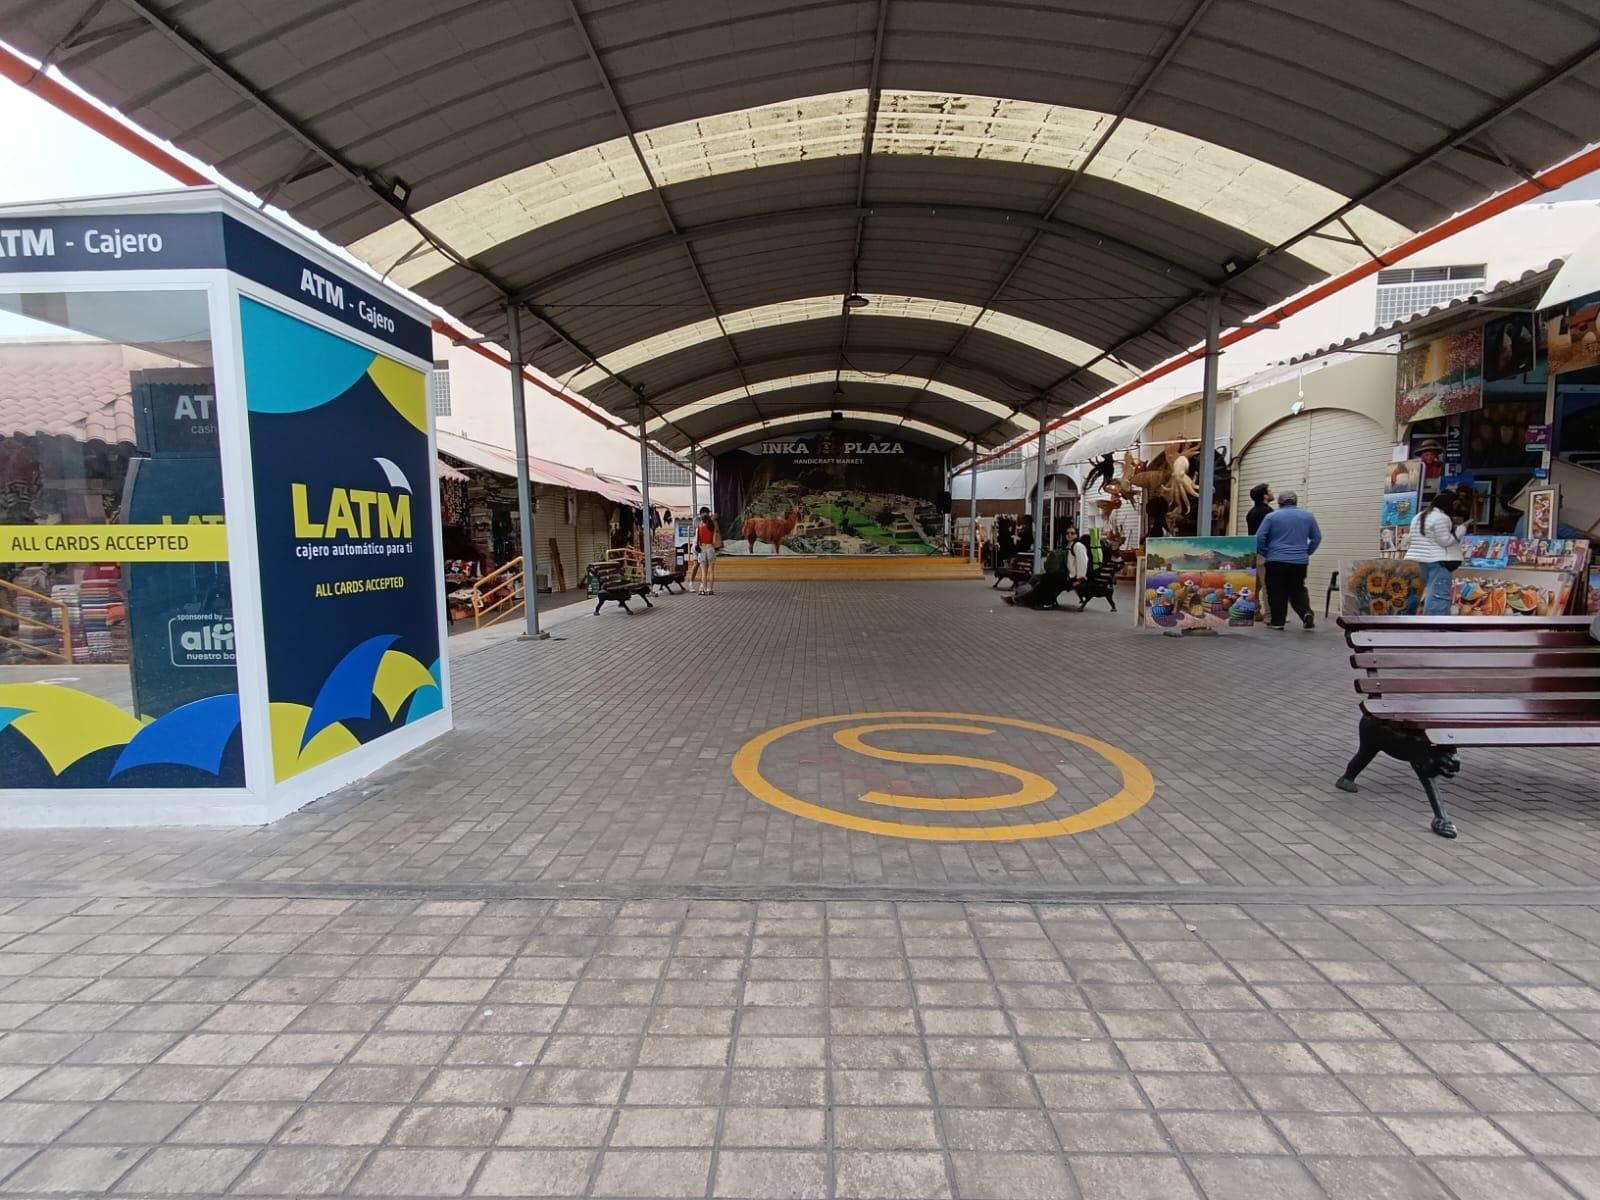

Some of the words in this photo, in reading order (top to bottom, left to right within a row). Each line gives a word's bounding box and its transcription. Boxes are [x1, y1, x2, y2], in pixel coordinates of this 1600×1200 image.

[84, 228, 163, 258] Cajero
[300, 268, 344, 310] ATM
[358, 300, 395, 333] Cajero
[762, 442, 809, 454] INKA
[843, 442, 904, 454] PLAZA
[291, 482, 413, 538] LATM
[11, 536, 41, 551] ALL
[45, 536, 100, 551] CARDS
[105, 535, 189, 551] ACCEPTED
[296, 543, 330, 560] cajero
[332, 542, 385, 556] automático
[386, 544, 405, 557] para
[406, 542, 413, 553] ti
[315, 583, 334, 598] ALL
[334, 580, 364, 595] CARDS
[365, 576, 404, 593] ACCEPTED
[176, 613, 213, 622] sponsored
[213, 613, 223, 621] by
[833, 723, 1057, 811] S
